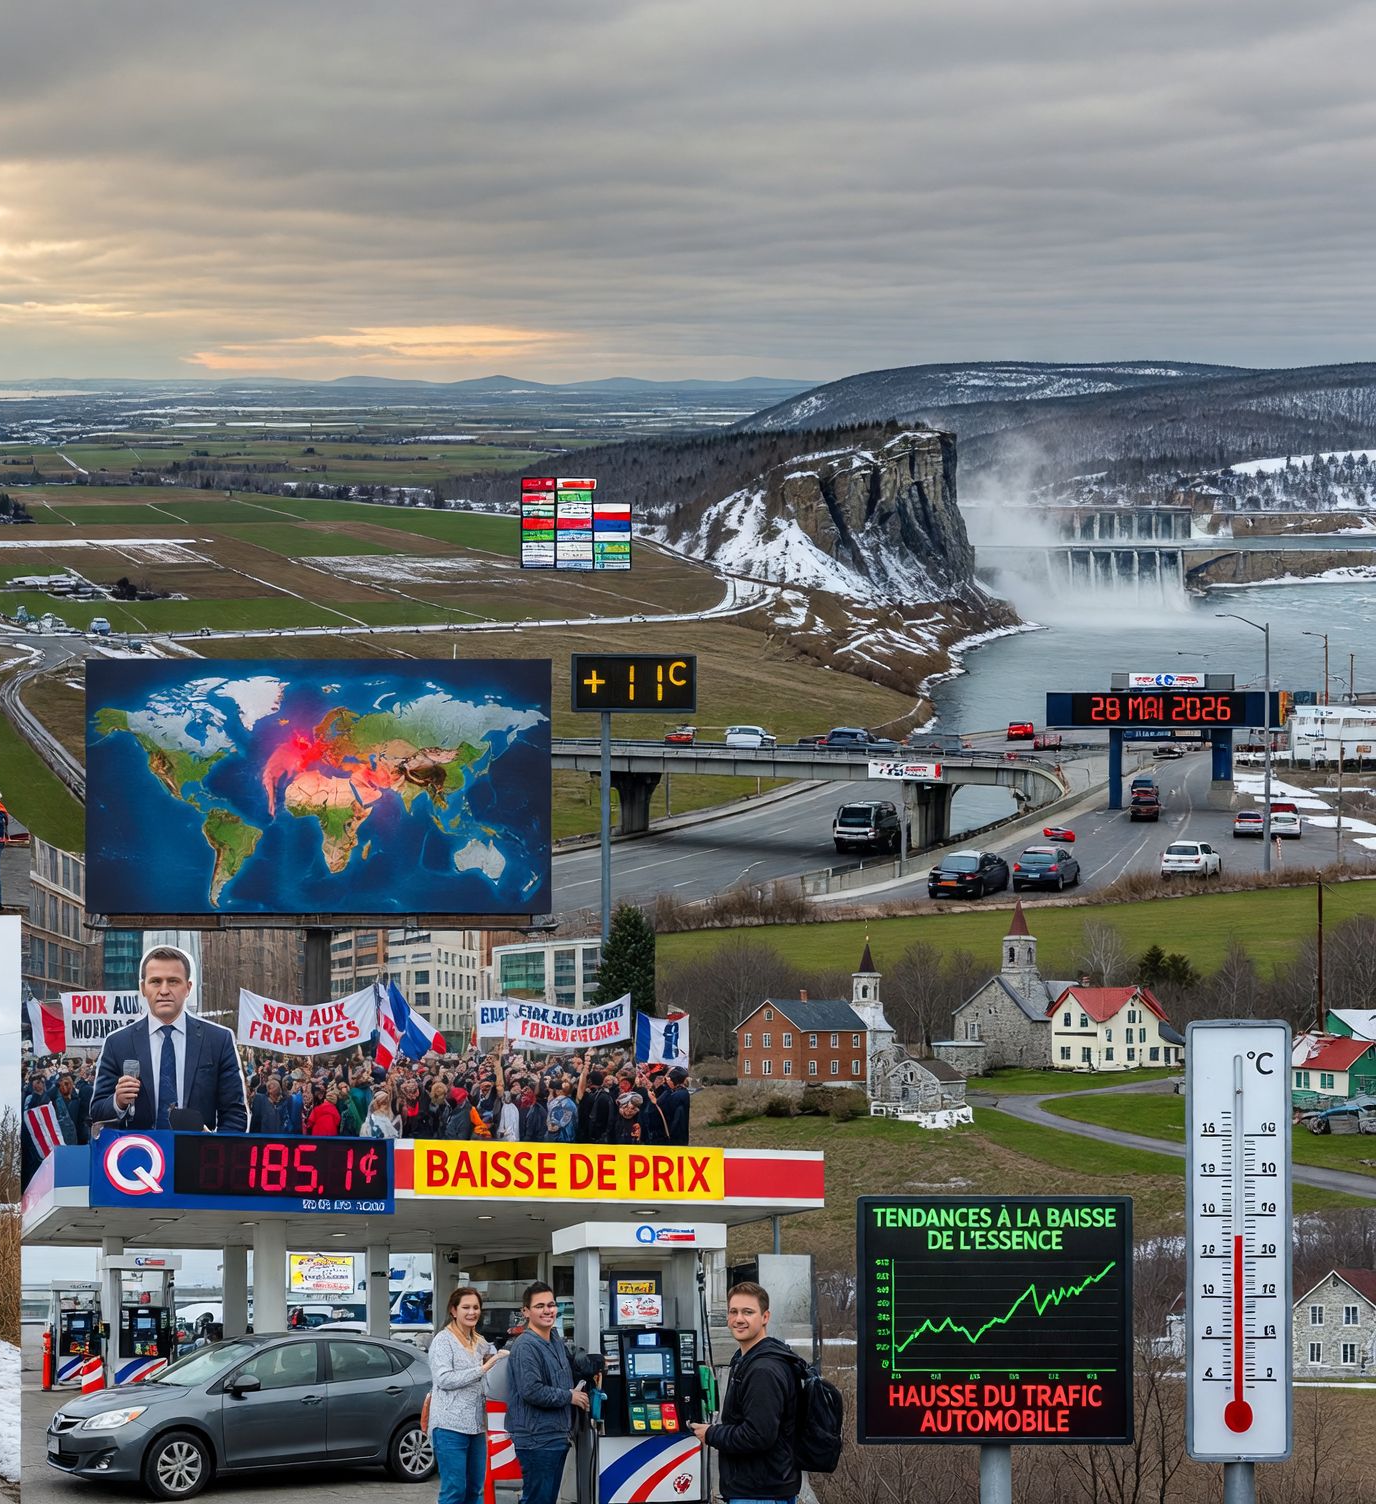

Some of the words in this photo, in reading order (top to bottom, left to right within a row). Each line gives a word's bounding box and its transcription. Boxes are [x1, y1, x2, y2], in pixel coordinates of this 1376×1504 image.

[1091, 697, 1121, 720] 28
[1128, 696, 1164, 720] MAI
[1172, 696, 1231, 720] 2026
[71, 995, 107, 1014] POIX
[264, 1003, 303, 1026] NON
[308, 1002, 349, 1027] AUX
[103, 1133, 166, 1195] Q
[426, 1150, 557, 1189] BAISSE
[570, 1153, 616, 1190] DE
[629, 1154, 711, 1192] PRIX
[873, 1208, 992, 1228] TENDANCES
[996, 1204, 1012, 1228] À
[1016, 1208, 1041, 1228] LA
[1046, 1208, 1117, 1228] BAISSE
[927, 1230, 954, 1250] DE
[959, 1230, 1063, 1250] L'ESSENCE
[889, 1385, 977, 1407] HAUSSE
[984, 1385, 1016, 1407] DU
[1022, 1385, 1103, 1407] TRAFIC
[920, 1410, 1070, 1432] AUTOMOBILE
